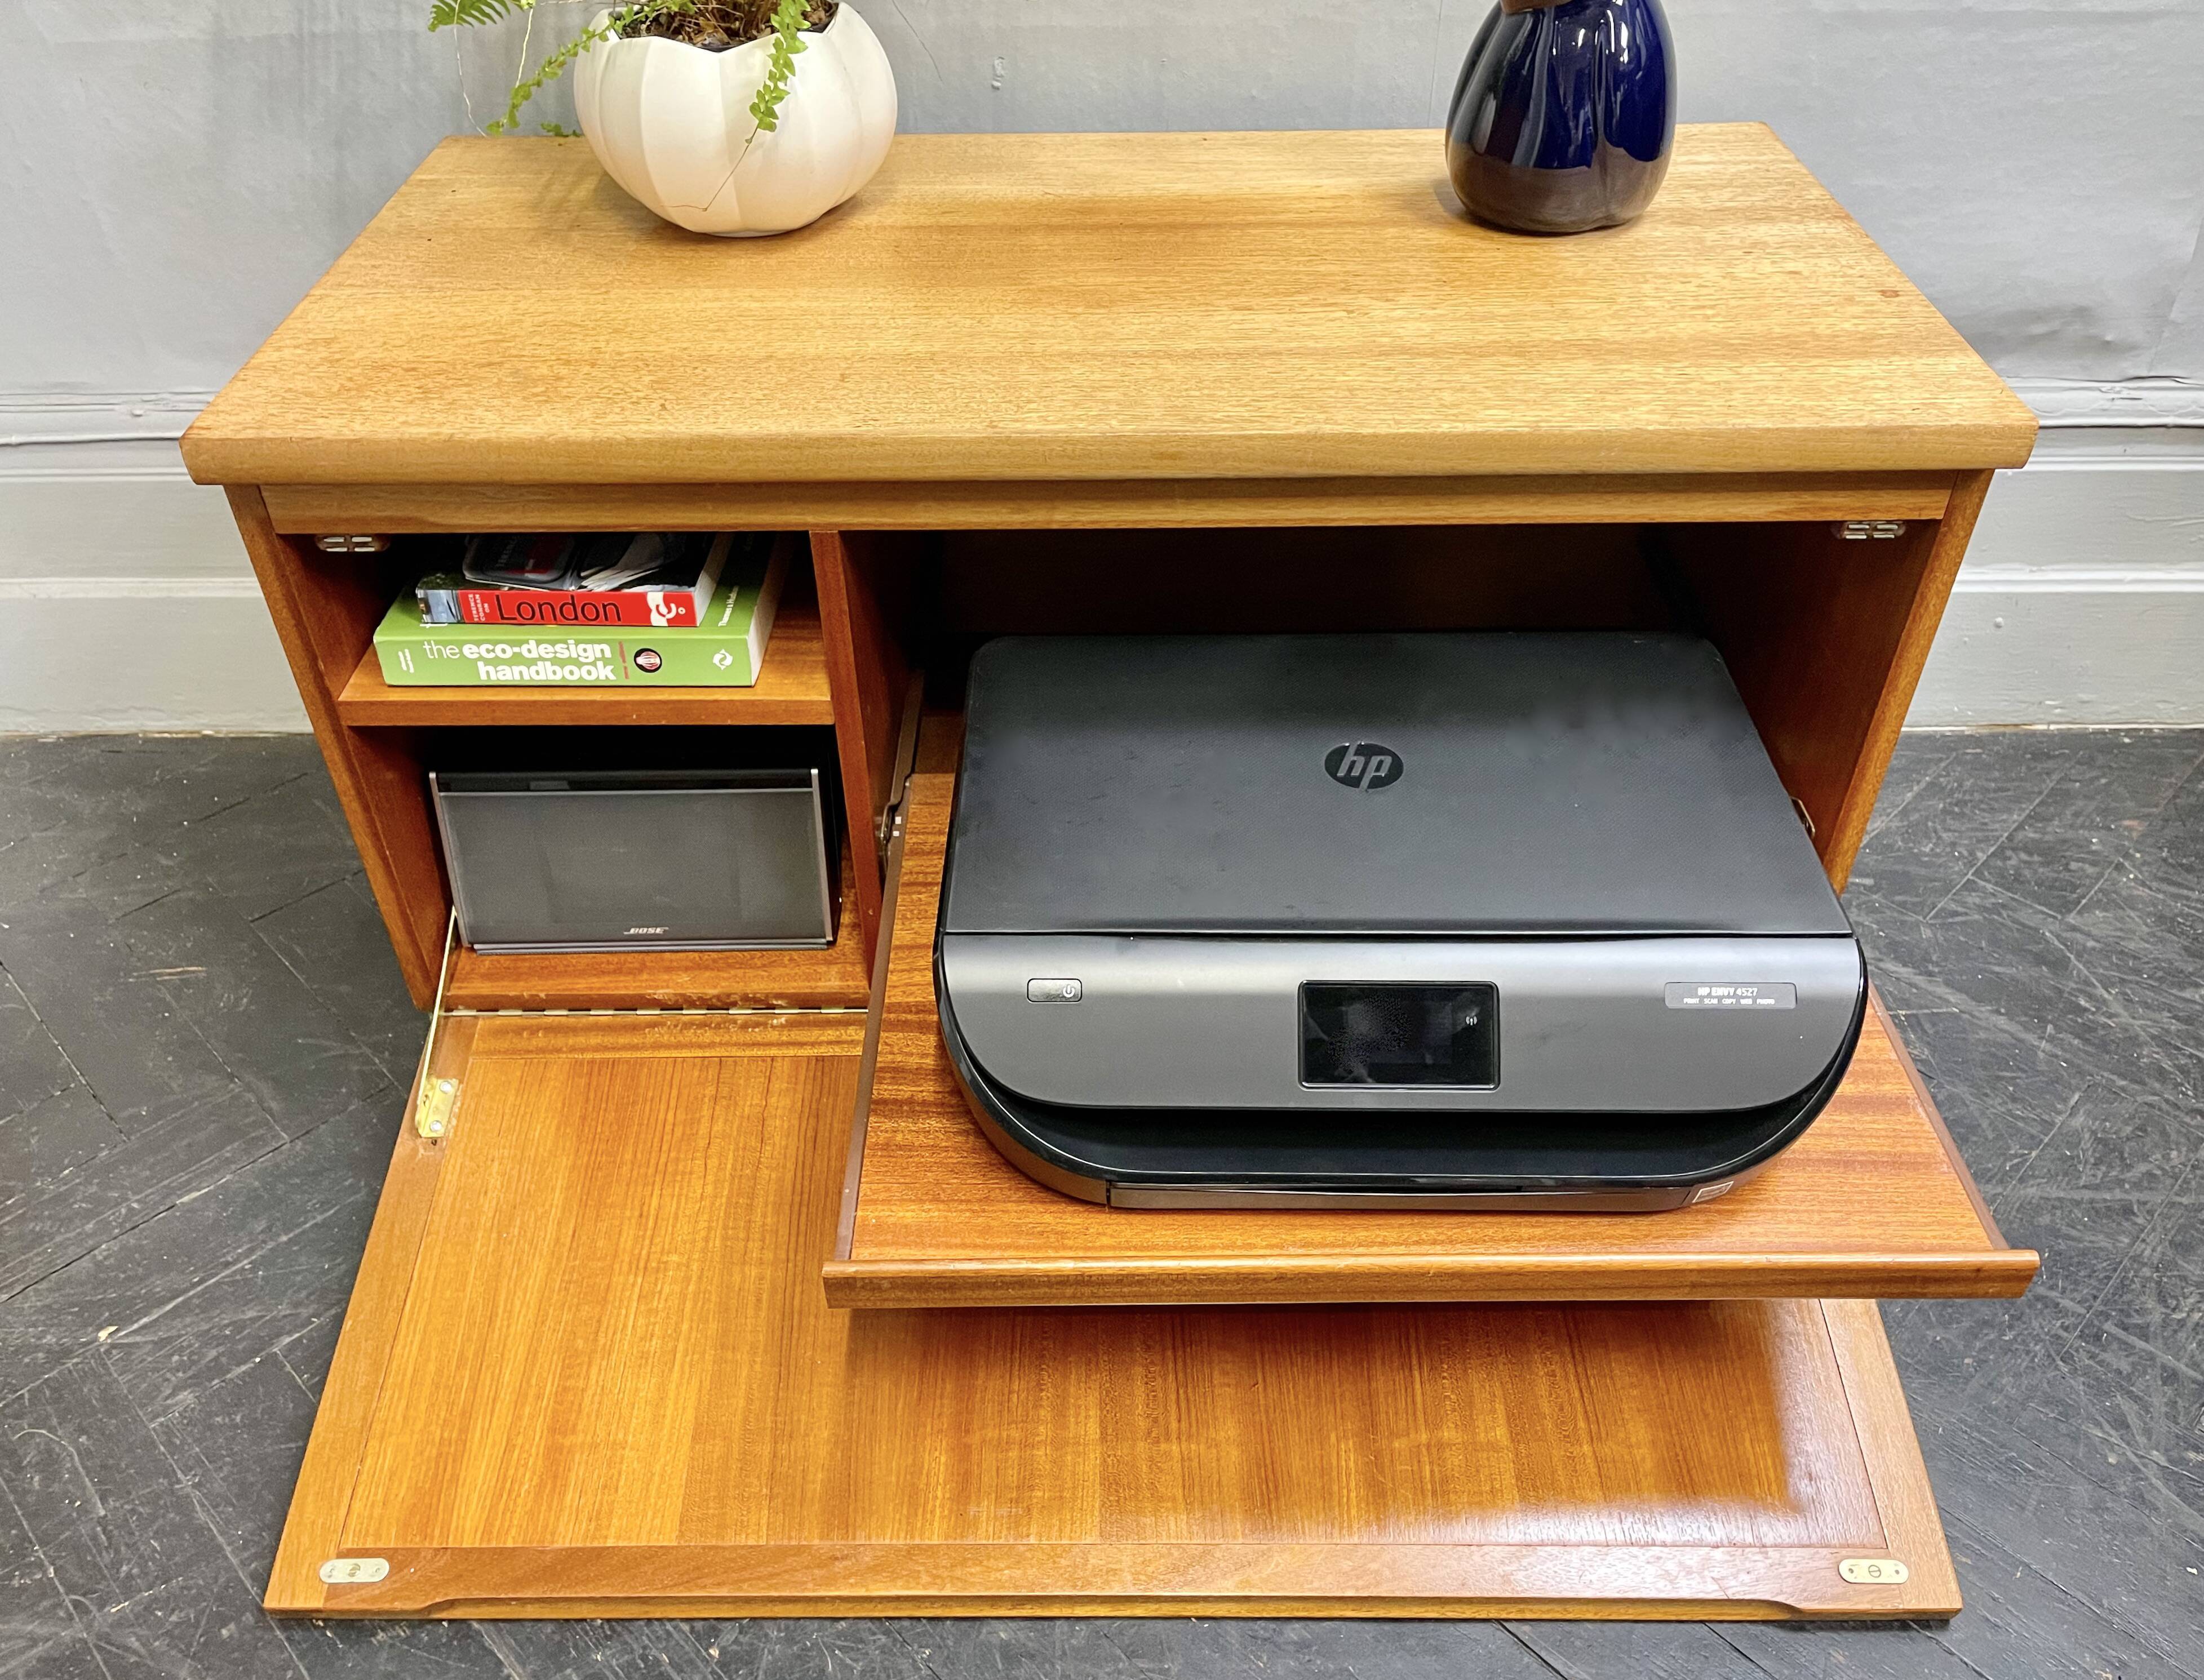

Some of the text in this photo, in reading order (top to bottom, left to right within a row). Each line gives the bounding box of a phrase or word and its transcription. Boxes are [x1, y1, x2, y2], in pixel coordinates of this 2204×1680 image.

[495, 594, 622, 622] London
[423, 640, 460, 659] the
[462, 639, 612, 663] eco-design
[477, 661, 617, 680] handbook
[1336, 742, 1393, 790] hp
[1698, 987, 1758, 996] HP ENVY 4527
